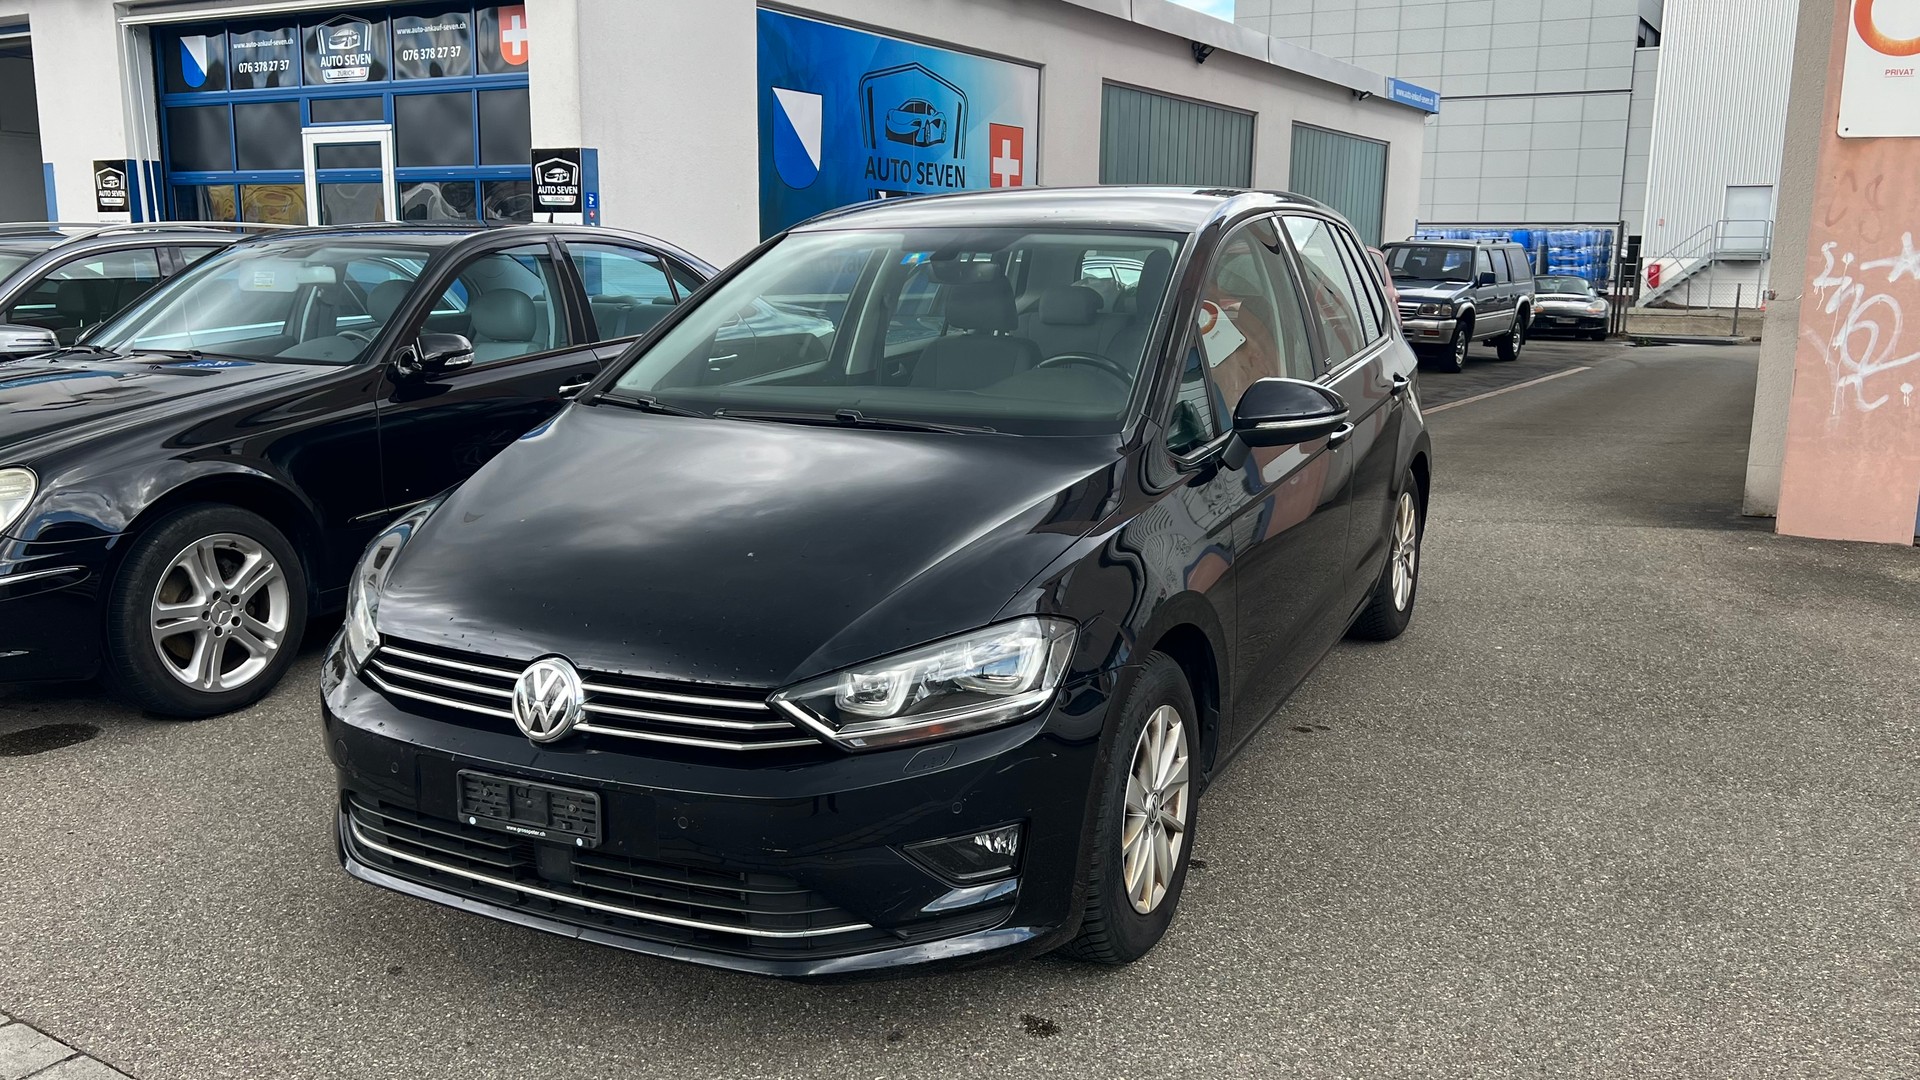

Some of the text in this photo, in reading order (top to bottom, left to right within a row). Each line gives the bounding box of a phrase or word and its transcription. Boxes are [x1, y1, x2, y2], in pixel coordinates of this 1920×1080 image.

[396, 21, 467, 35] www.auto-ankauf-seven.ch
[233, 37, 294, 49] www.auto-ankauf-seven.ch
[320, 52, 372, 68] AUTO SEVEN
[402, 45, 461, 61] 076 378 27 37
[238, 59, 290, 74] 076 378 27 37
[1884, 68, 1915, 76] PRIVAT
[864, 155, 966, 189] AUTO SEVEN
[537, 186, 578, 194] AUTO SEVEN
[514, 661, 577, 741] VW
[505, 825, 546, 837] www.grosspeter.ch
